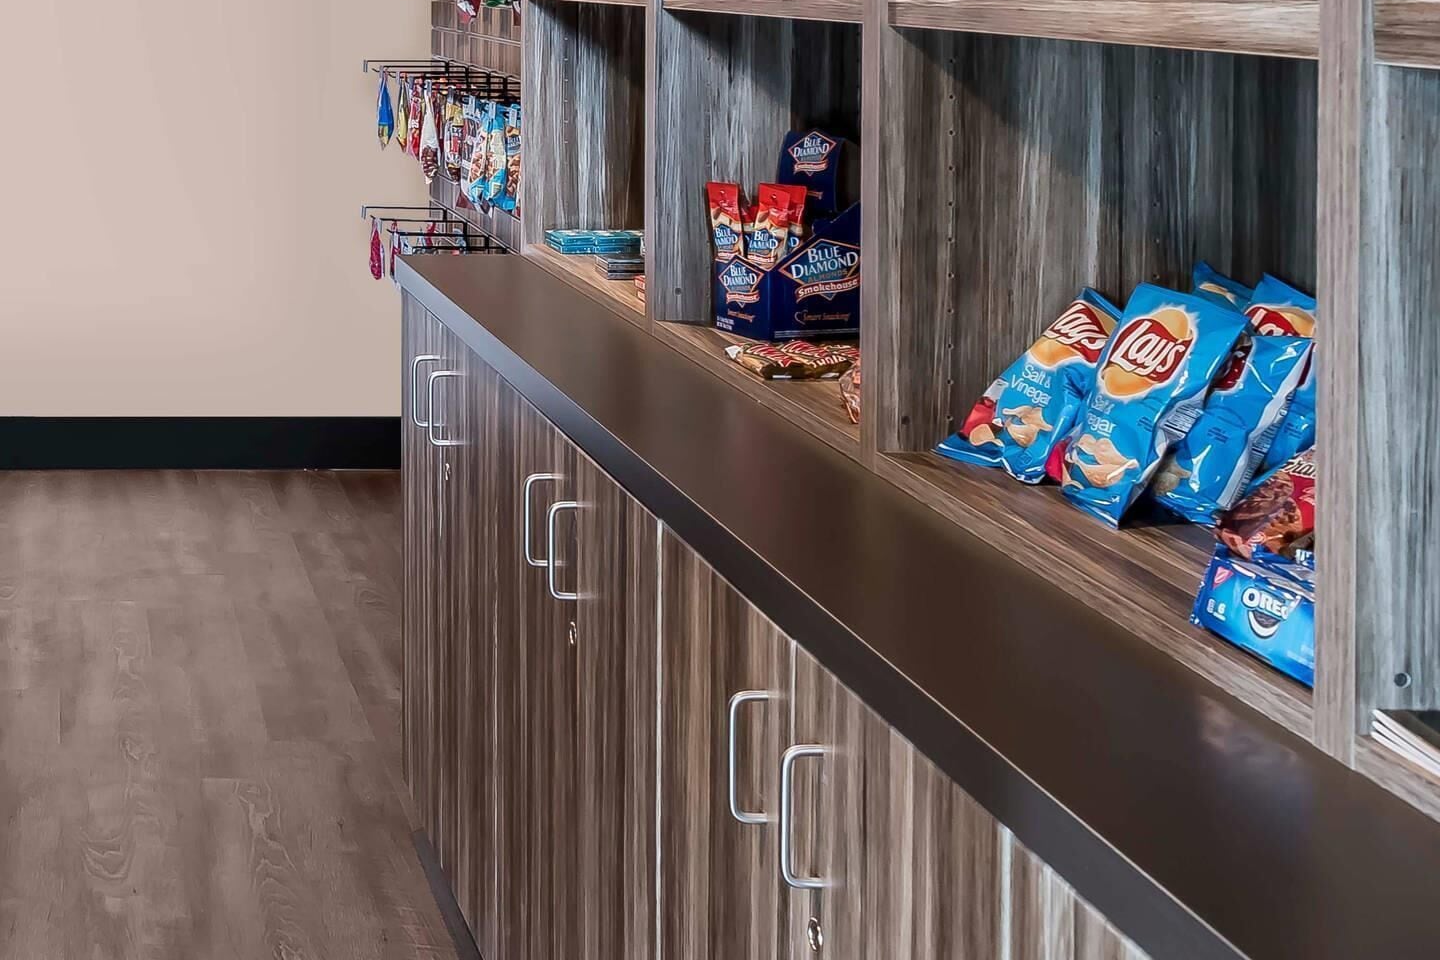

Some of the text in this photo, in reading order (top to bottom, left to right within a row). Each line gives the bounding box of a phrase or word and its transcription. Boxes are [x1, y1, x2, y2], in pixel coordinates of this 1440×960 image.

[803, 137, 822, 149] BLUE
[807, 246, 842, 264] BLUE
[730, 265, 747, 278] BLUE
[791, 251, 859, 279] DIAMOND
[723, 273, 757, 287] DIAMOND
[798, 278, 859, 298] Smokehouse
[1021, 364, 1045, 388] Salt
[1010, 374, 1052, 407] Vinegar
